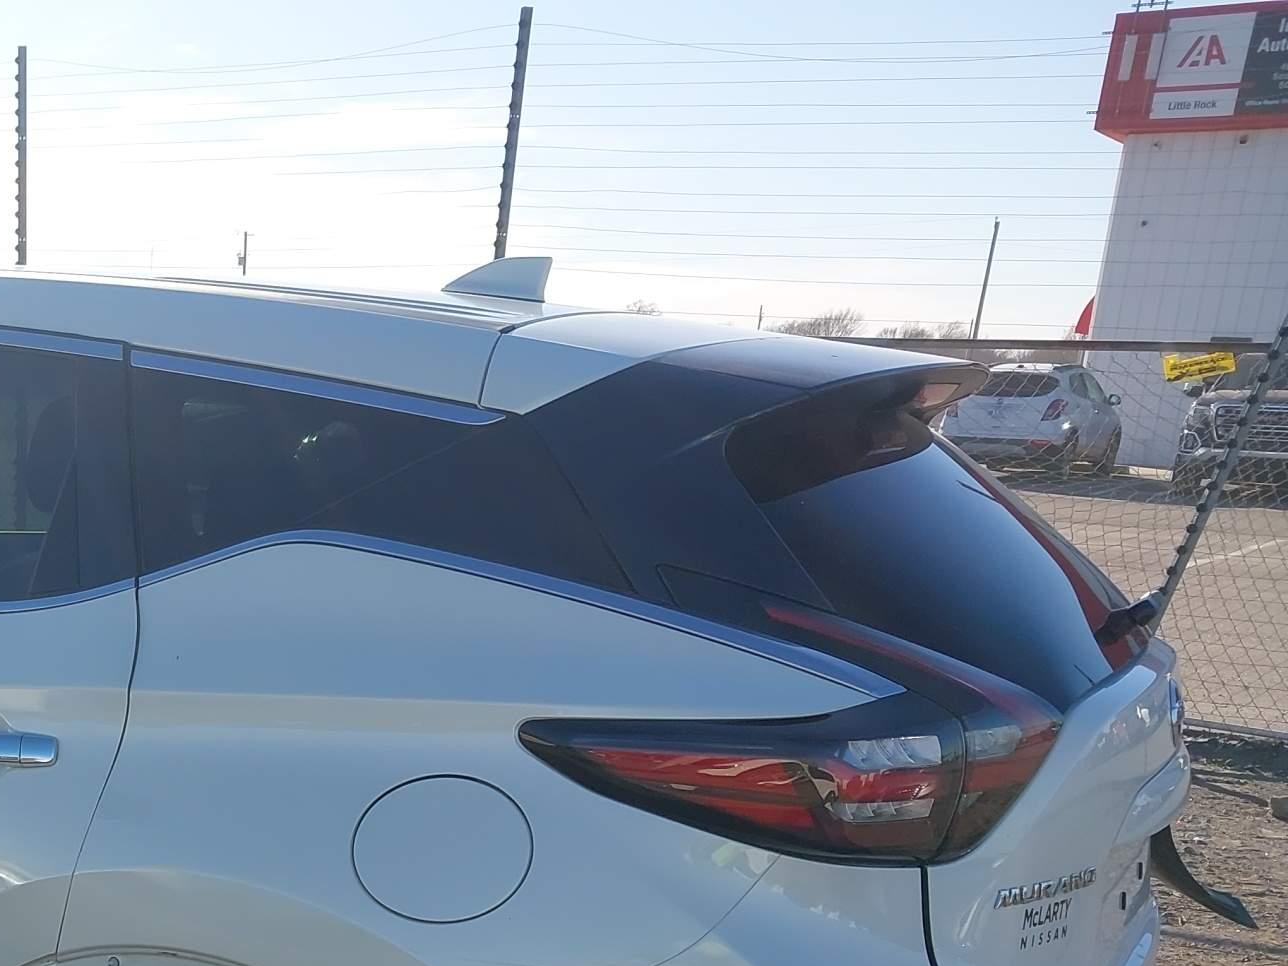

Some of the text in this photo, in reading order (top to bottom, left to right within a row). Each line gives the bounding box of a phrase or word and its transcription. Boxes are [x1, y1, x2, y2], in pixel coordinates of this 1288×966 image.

[1168, 100, 1217, 111] Little Rock
[994, 865, 1097, 909] MURANO
[1022, 898, 1072, 930] McLARTY
[1020, 925, 1068, 950] NISSAN
